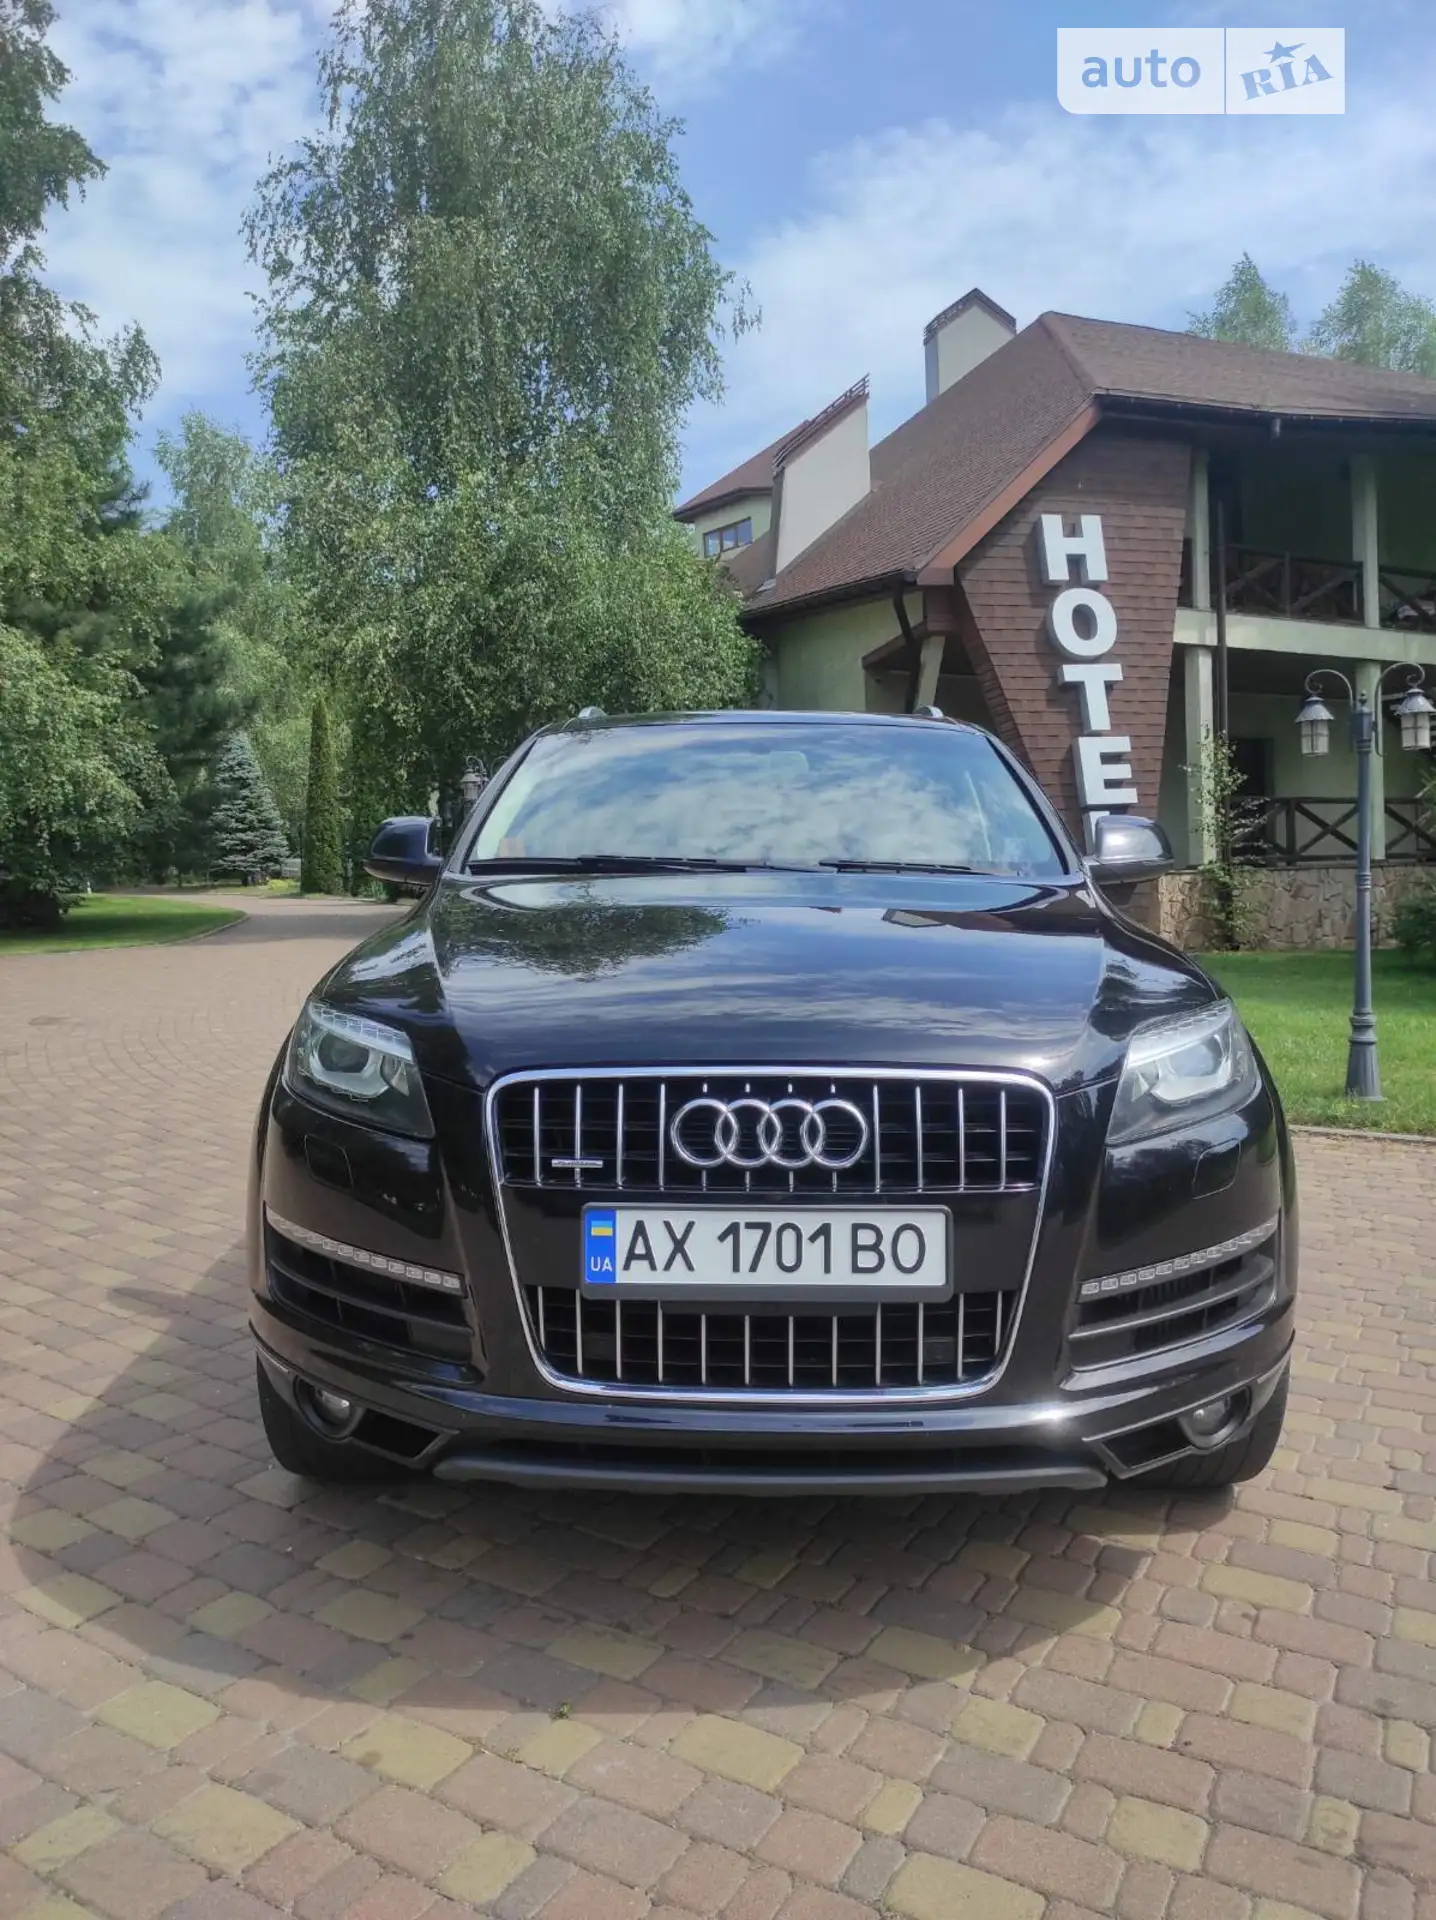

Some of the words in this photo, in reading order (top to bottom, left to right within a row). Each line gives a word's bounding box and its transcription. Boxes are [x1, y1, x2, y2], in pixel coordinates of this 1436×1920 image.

[590, 1255, 614, 1273] UA
[622, 1219, 697, 1273] AX
[716, 1221, 832, 1275] 1701
[850, 1221, 927, 1275] BO
